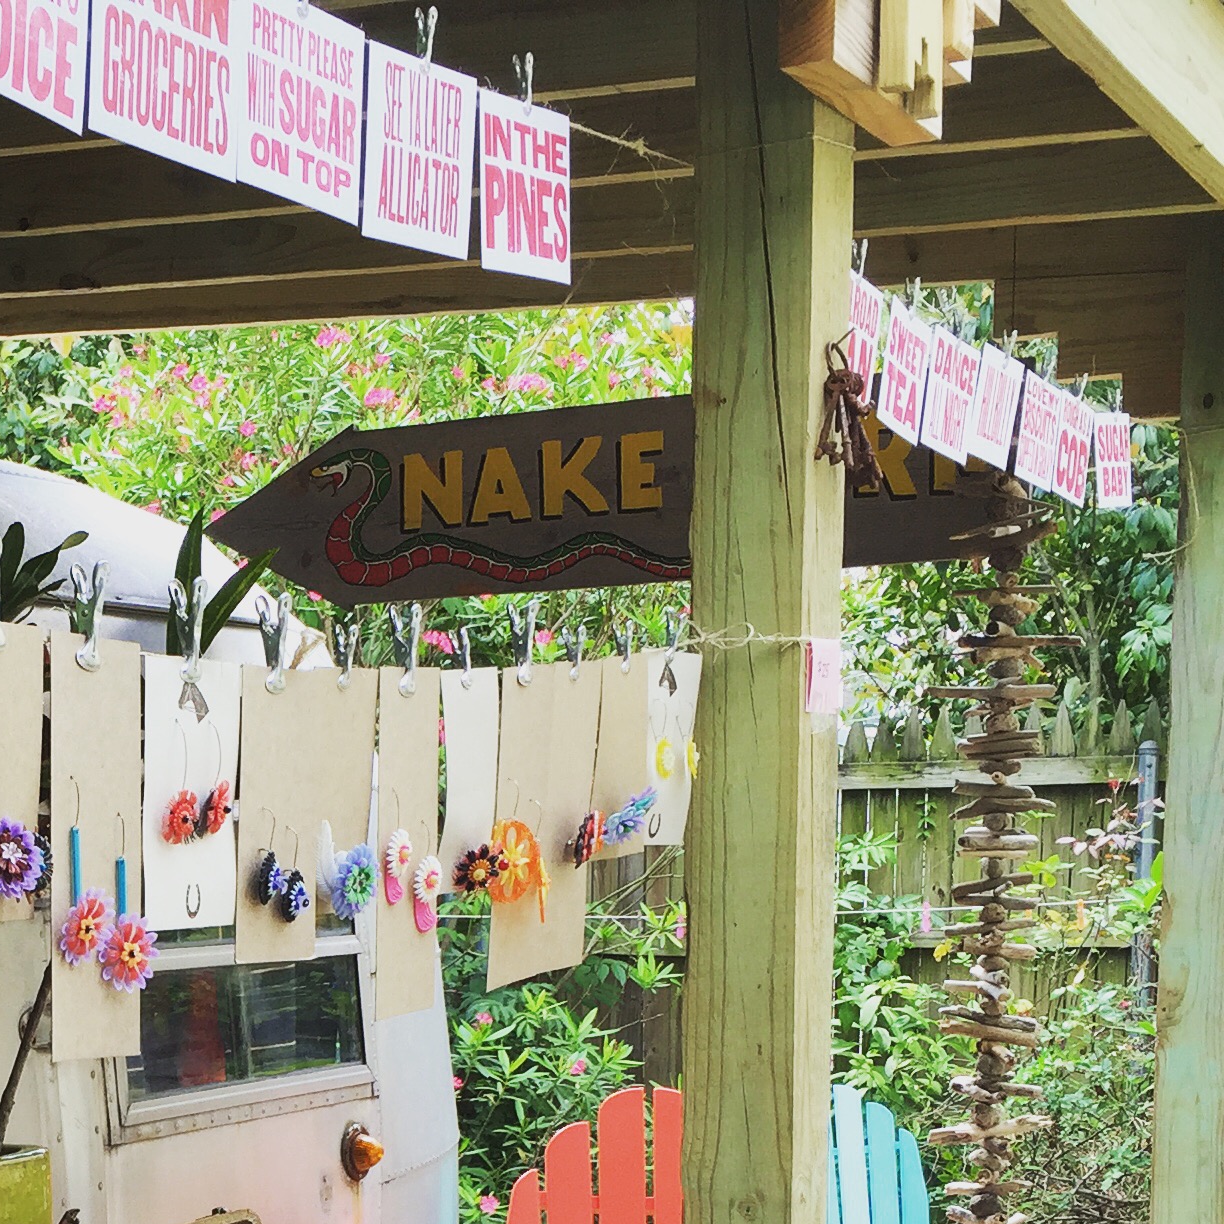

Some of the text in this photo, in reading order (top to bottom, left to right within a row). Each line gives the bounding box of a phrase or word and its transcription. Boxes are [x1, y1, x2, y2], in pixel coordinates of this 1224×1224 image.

[102, 4, 230, 156] GROCERIES
[252, 2, 304, 68] PRETTY
[308, 30, 355, 91] PLEASE
[247, 51, 356, 166] WITH SUGAR
[383, 60, 462, 160] SEE YA LATER
[484, 112, 568, 176] IN THE
[250, 132, 351, 197] ON TOP
[377, 142, 460, 238] ALLIGATOR
[484, 163, 568, 263] PINES
[849, 280, 879, 339] ROAD
[889, 316, 928, 380] SWEET
[934, 337, 977, 396] DANCE
[885, 360, 916, 432] TEA
[1026, 377, 1051, 405] LOVE
[1056, 428, 1087, 499] COB
[1098, 424, 1130, 463] SUGAR
[400, 430, 664, 533] NAKE
[1102, 466, 1129, 498] BABY
